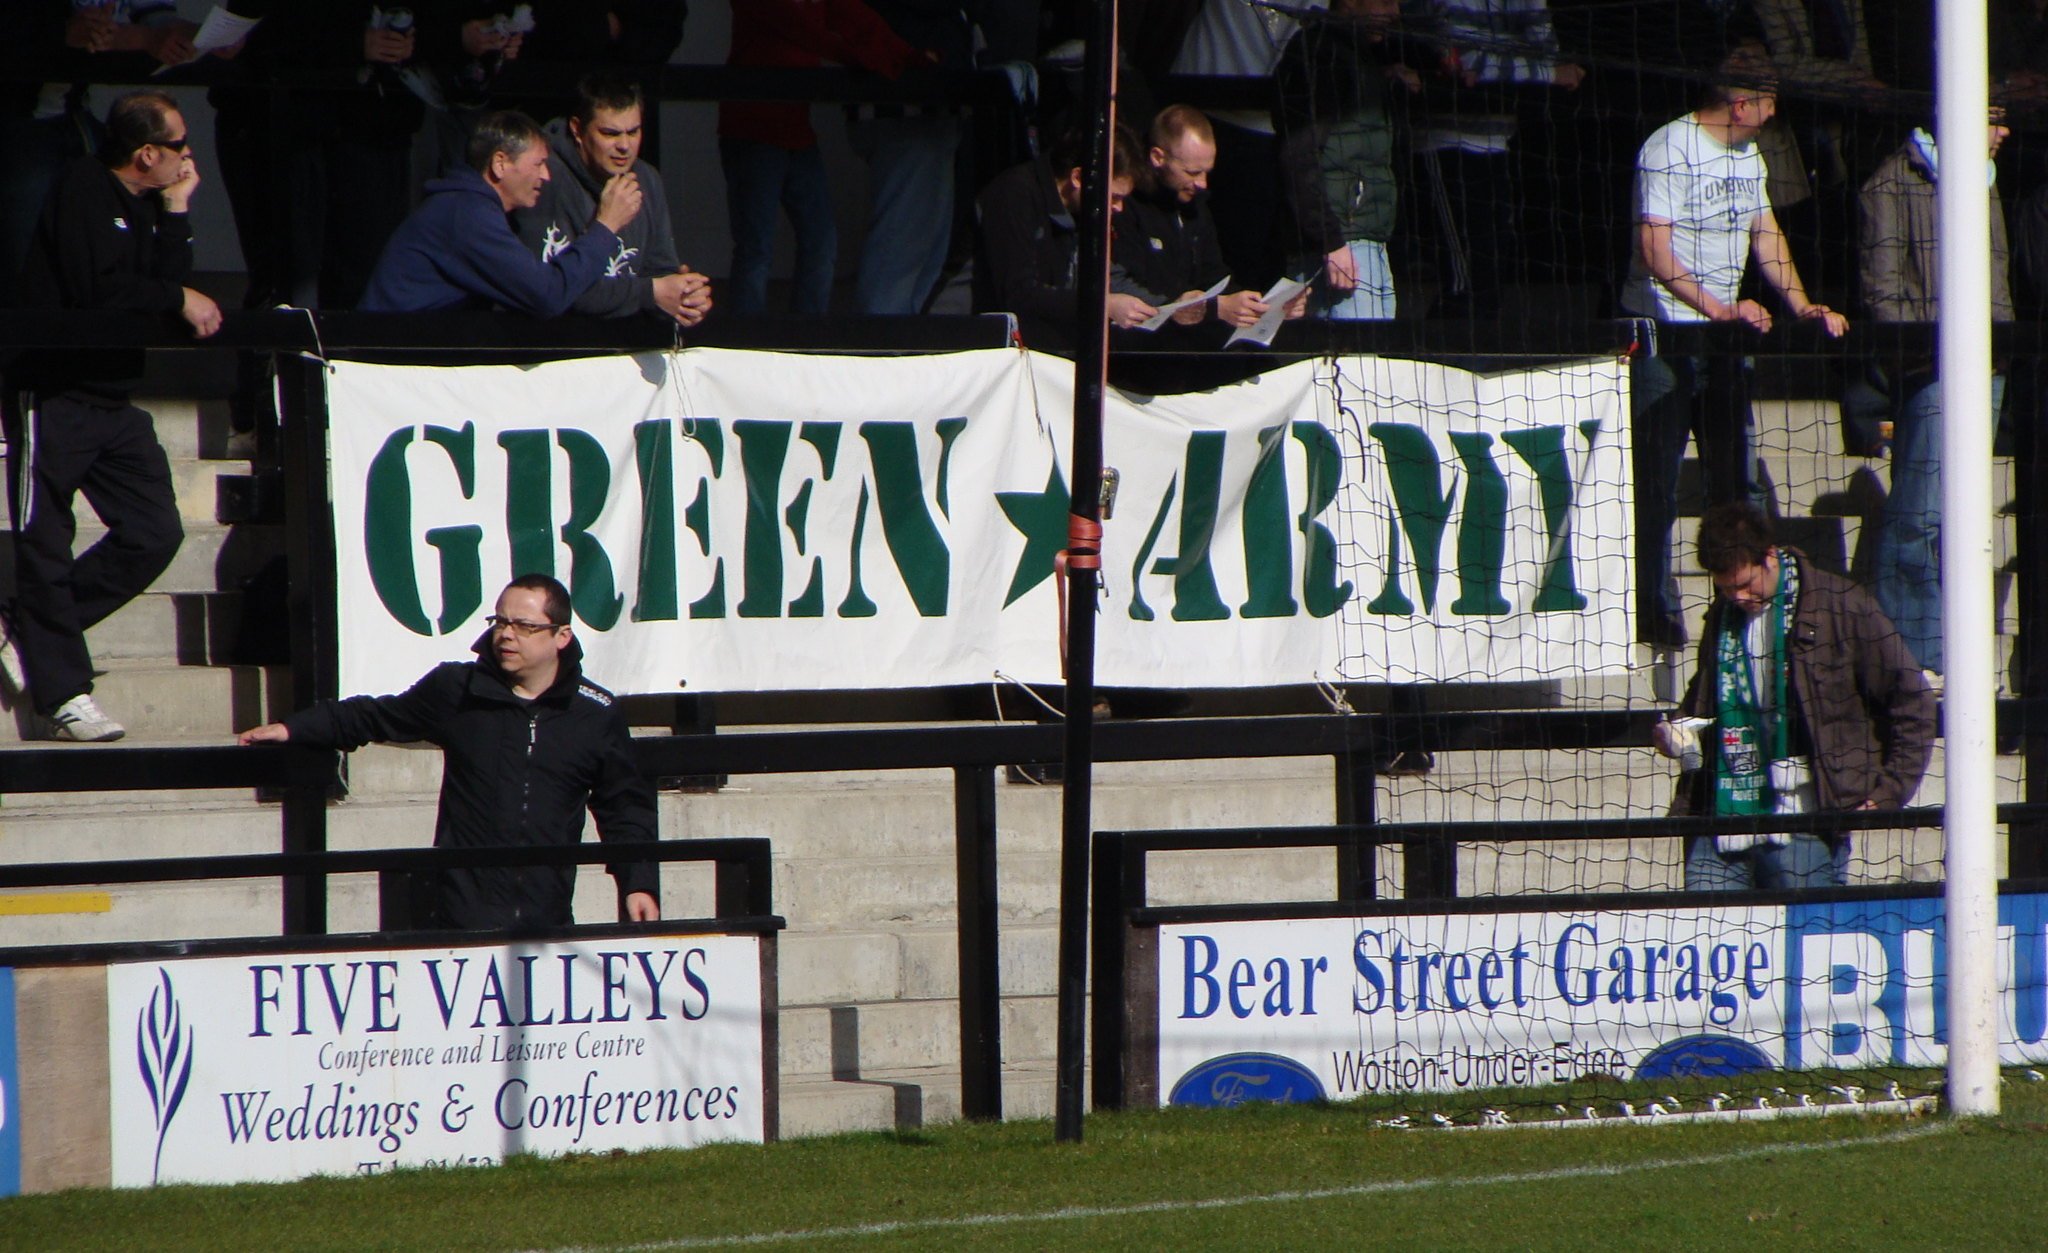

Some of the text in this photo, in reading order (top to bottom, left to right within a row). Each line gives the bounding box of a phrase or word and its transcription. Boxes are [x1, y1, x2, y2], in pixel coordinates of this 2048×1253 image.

[364, 416, 1603, 637] GREEN ARMY
[248, 948, 710, 1037] FIVE VALLEYS
[1177, 922, 1770, 1025] Bear Street Garage
[319, 1030, 645, 1076] Conference and Leisure Centre
[220, 1070, 738, 1153] Weddings & Conferences
